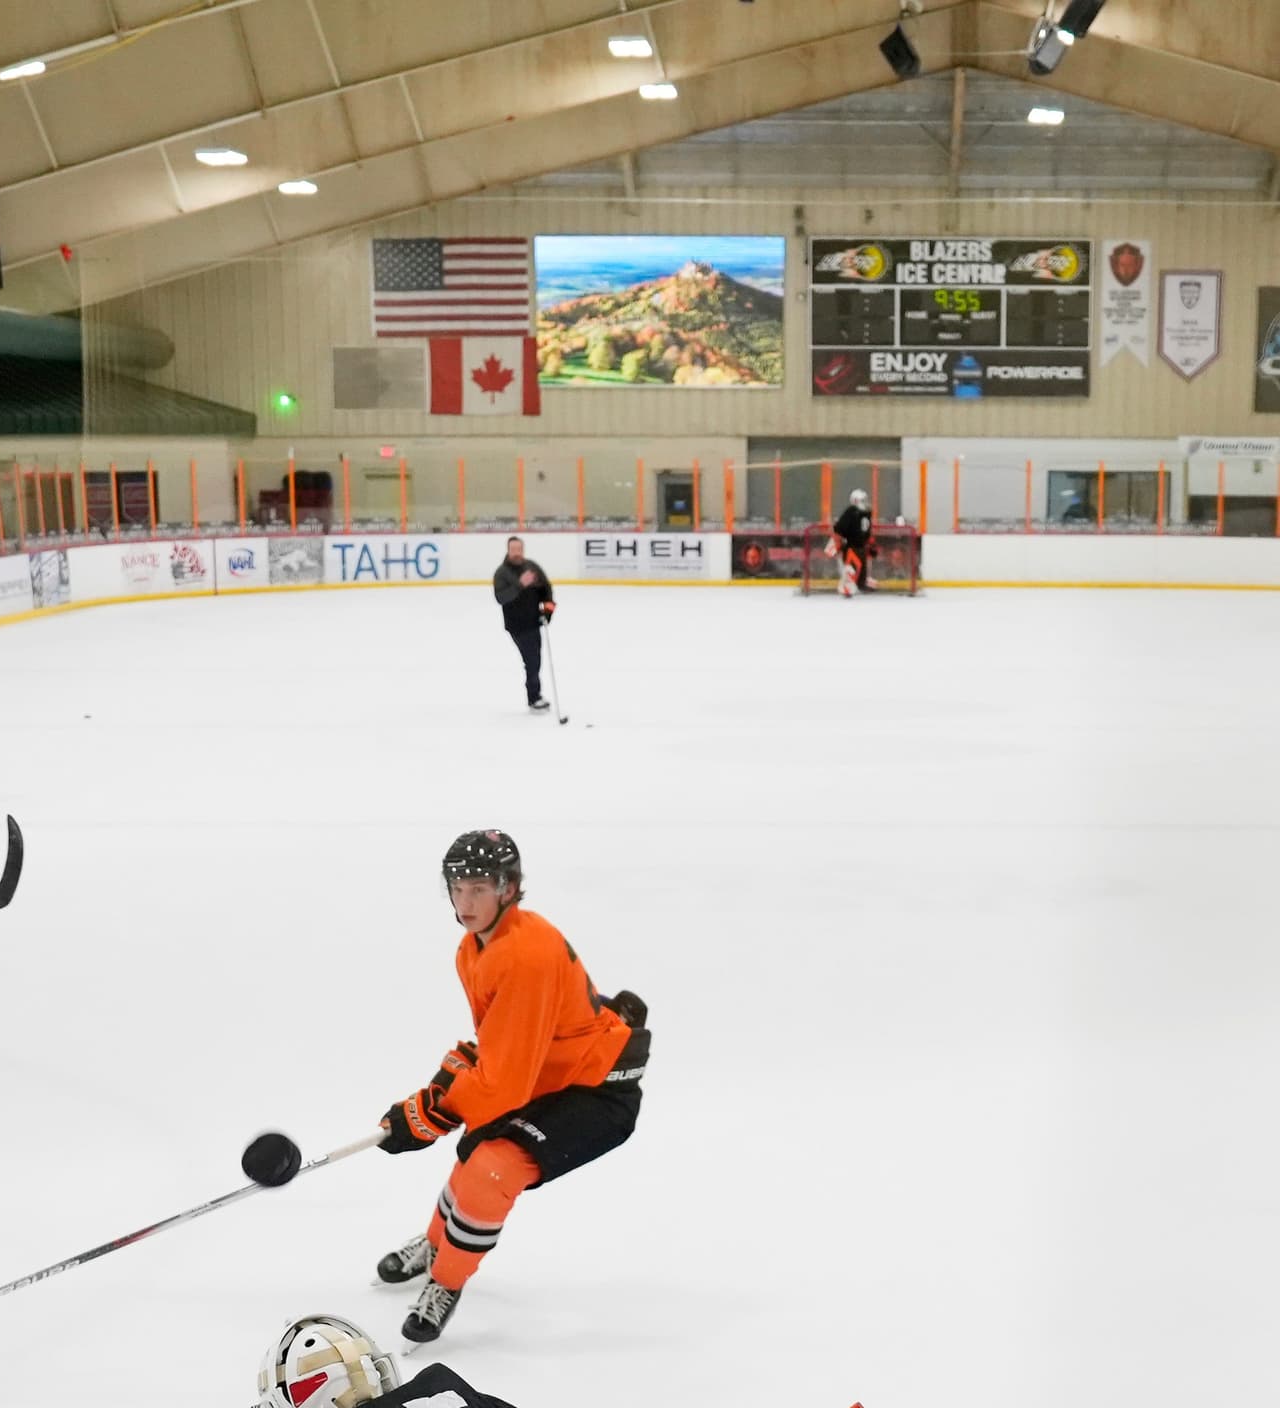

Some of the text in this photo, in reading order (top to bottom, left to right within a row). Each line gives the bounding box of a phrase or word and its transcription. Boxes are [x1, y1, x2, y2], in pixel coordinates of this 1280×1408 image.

[910, 241, 993, 262] BLAZERS
[896, 263, 928, 283] ICE
[934, 289, 982, 313] 9:55
[871, 352, 949, 372] ENJOY
[871, 372, 948, 382] EVERY SECOND
[986, 366, 1085, 380] POWERADE
[332, 542, 441, 581] TAHG
